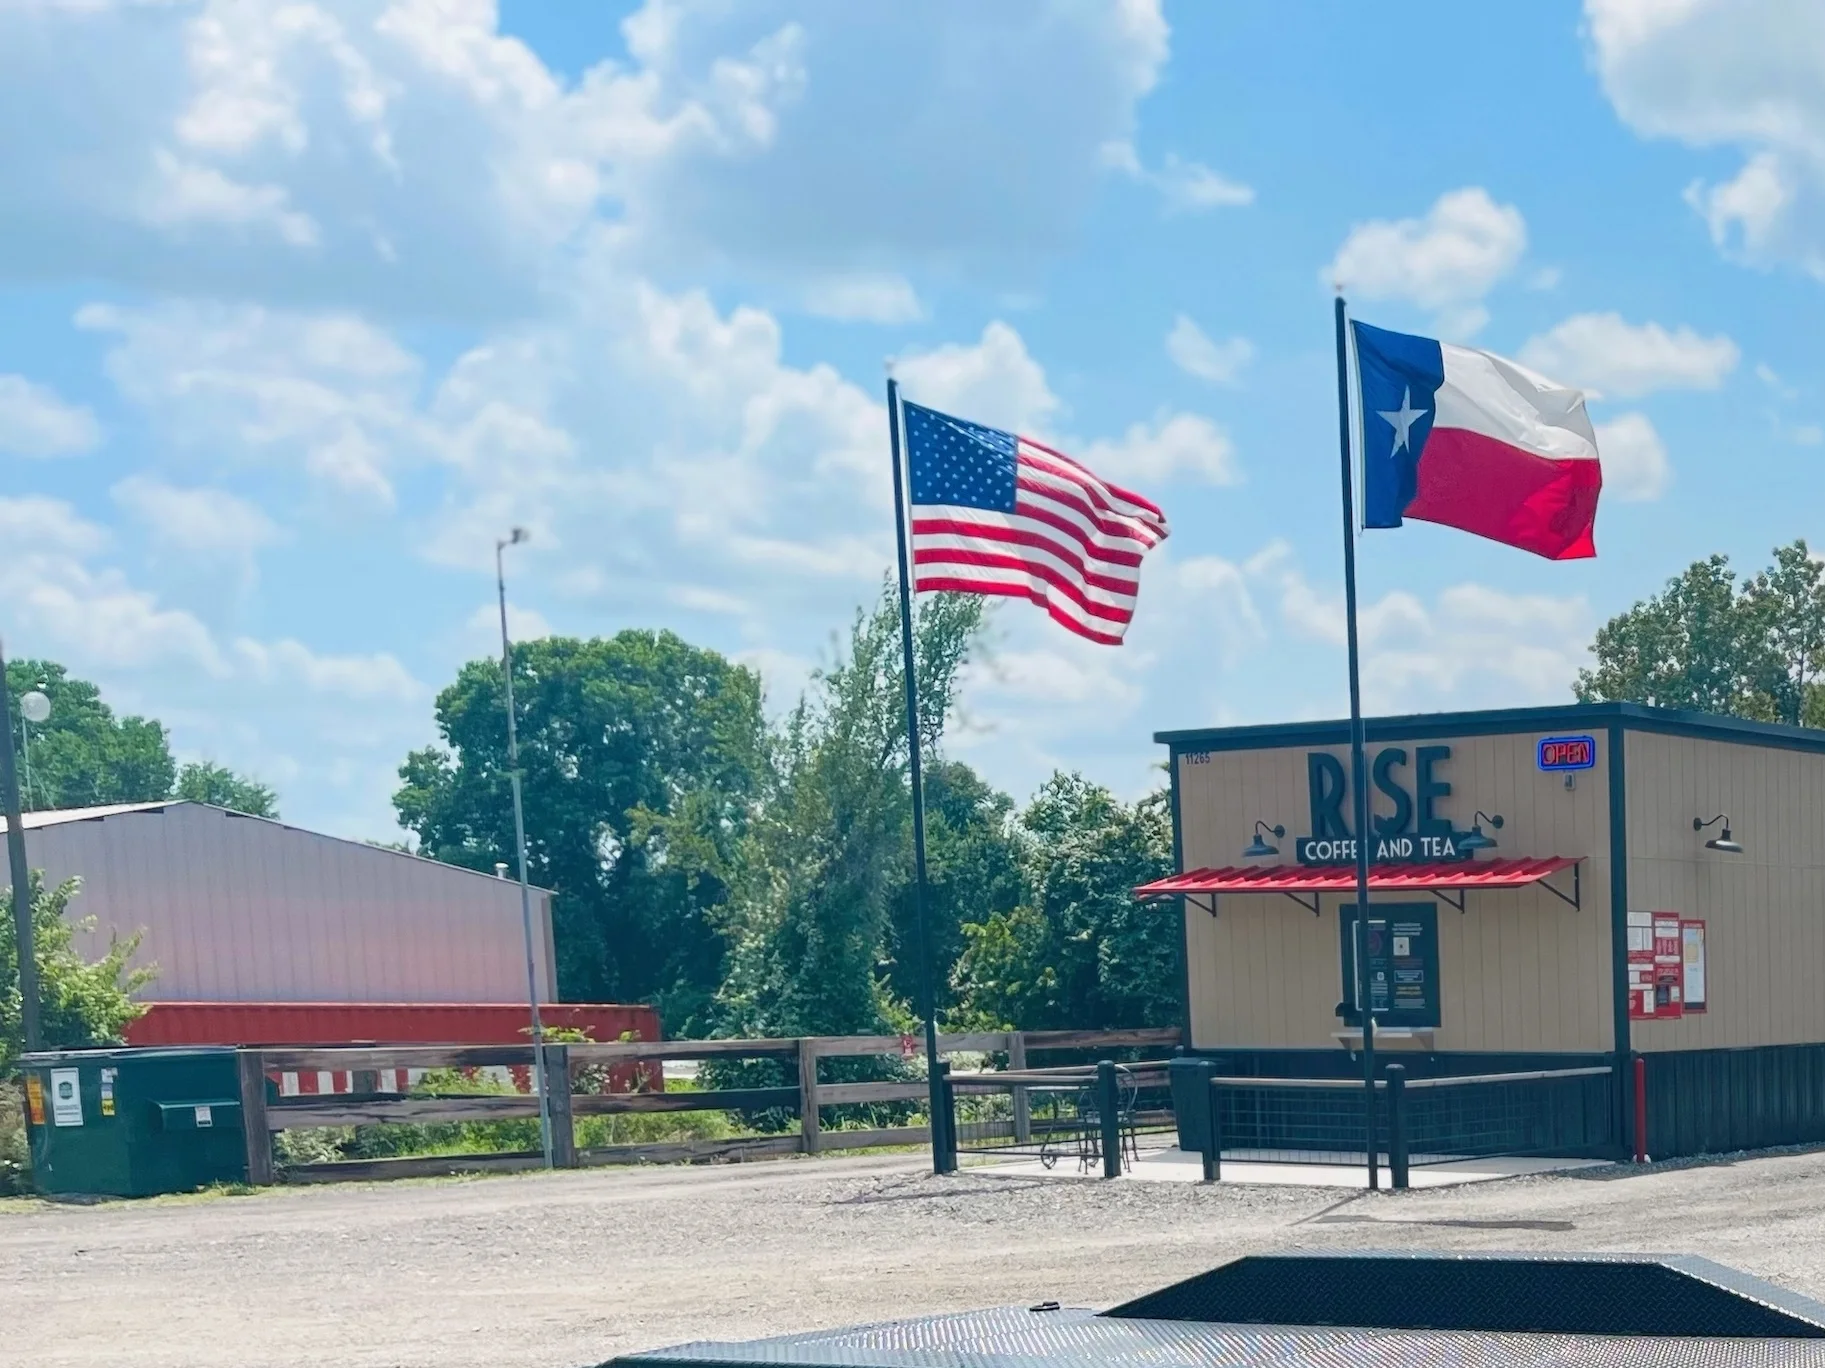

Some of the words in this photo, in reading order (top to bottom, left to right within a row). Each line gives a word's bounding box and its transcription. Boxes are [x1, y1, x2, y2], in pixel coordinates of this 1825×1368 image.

[1186, 752, 1211, 765] 11265
[1542, 742, 1590, 765] OPEN
[1308, 746, 1453, 838] RSE
[1305, 840, 1358, 860] COFFE
[1377, 838, 1413, 858] AND
[1420, 837, 1456, 857] TEA
